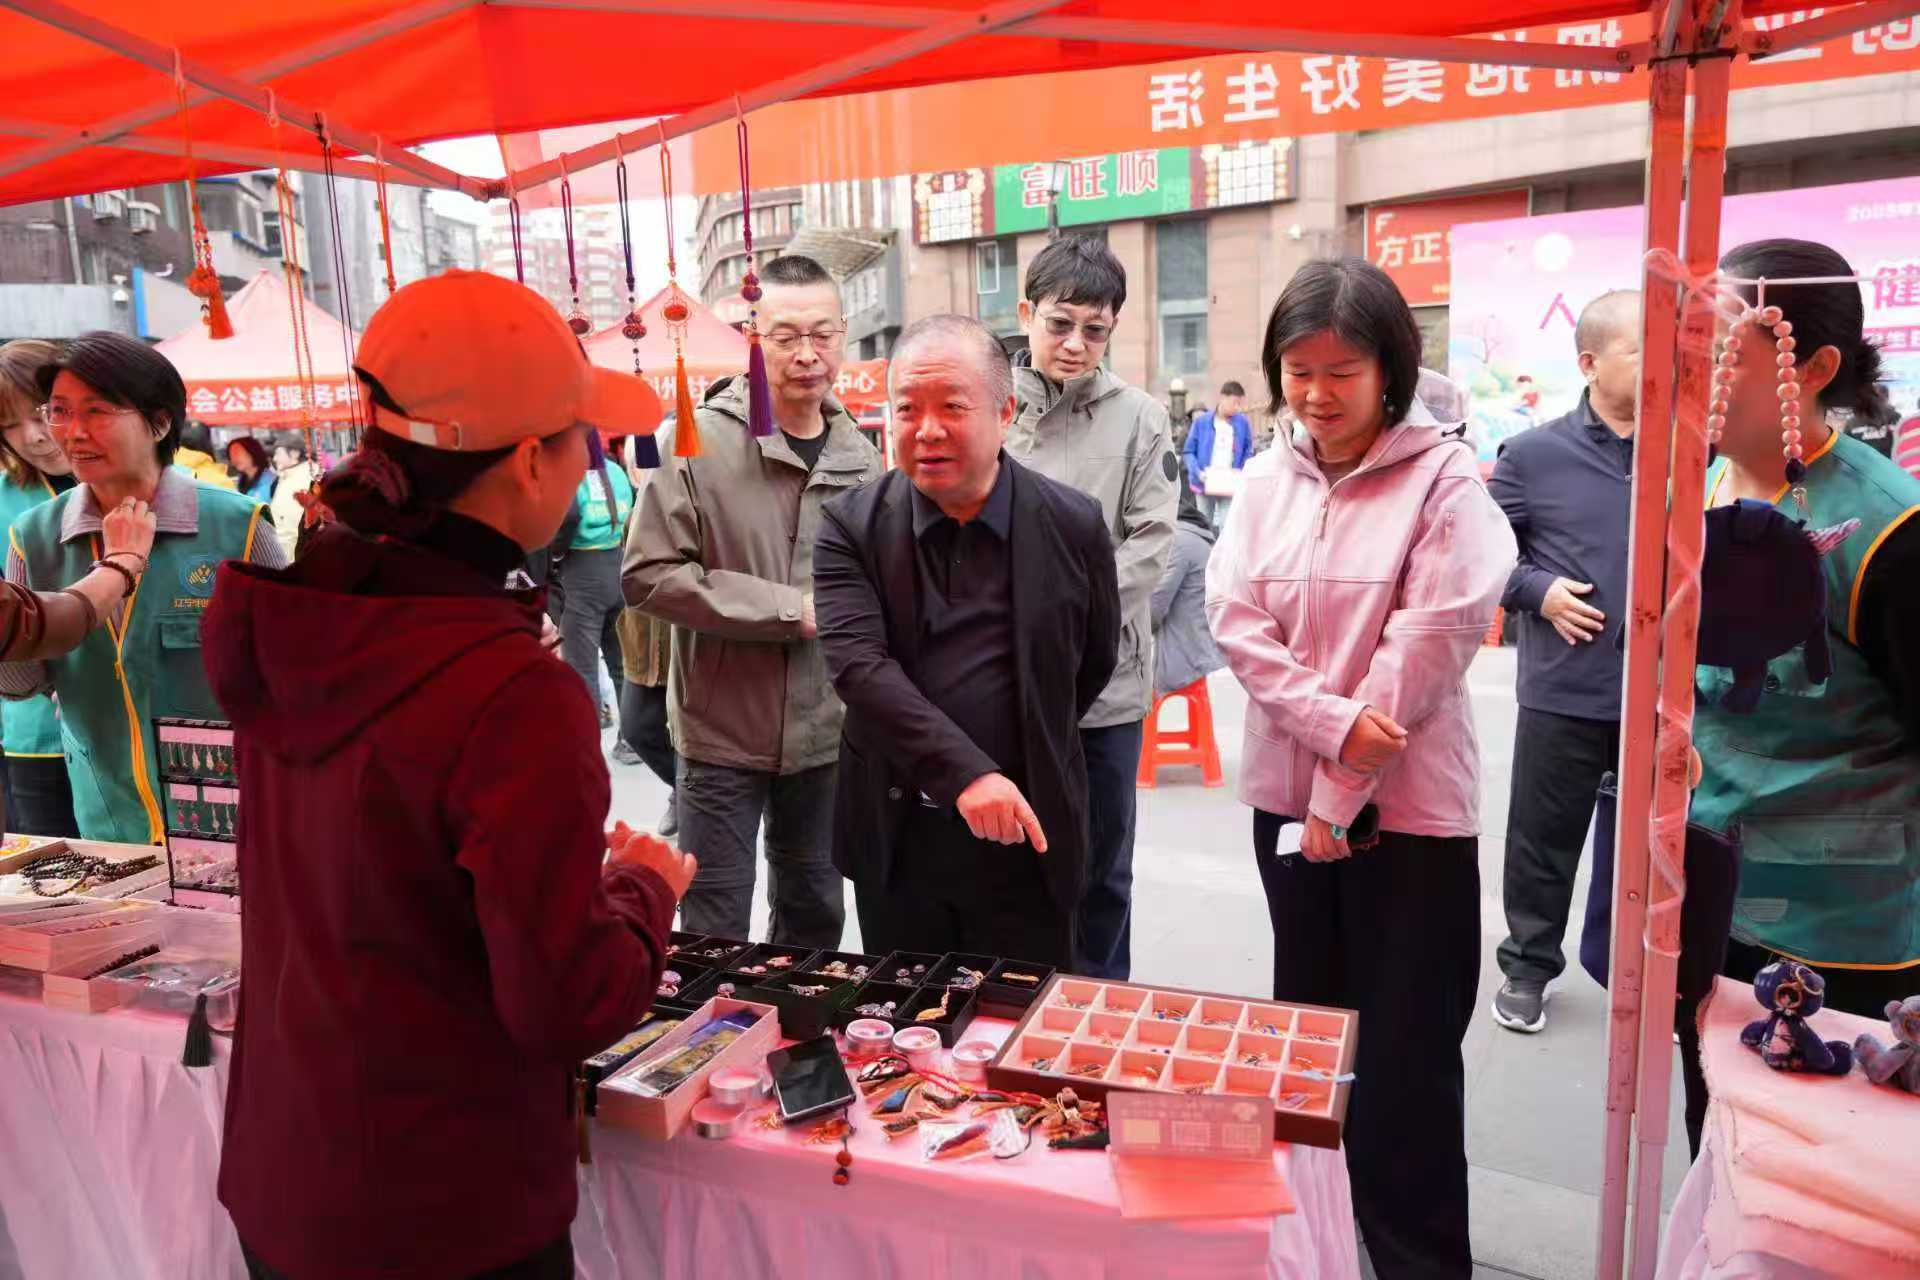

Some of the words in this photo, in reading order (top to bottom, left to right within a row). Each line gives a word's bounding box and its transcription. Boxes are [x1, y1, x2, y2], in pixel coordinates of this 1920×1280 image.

[1020, 150, 1159, 208] 富旺顺
[1375, 231, 1452, 270] 方正
[832, 370, 877, 395] 中心
